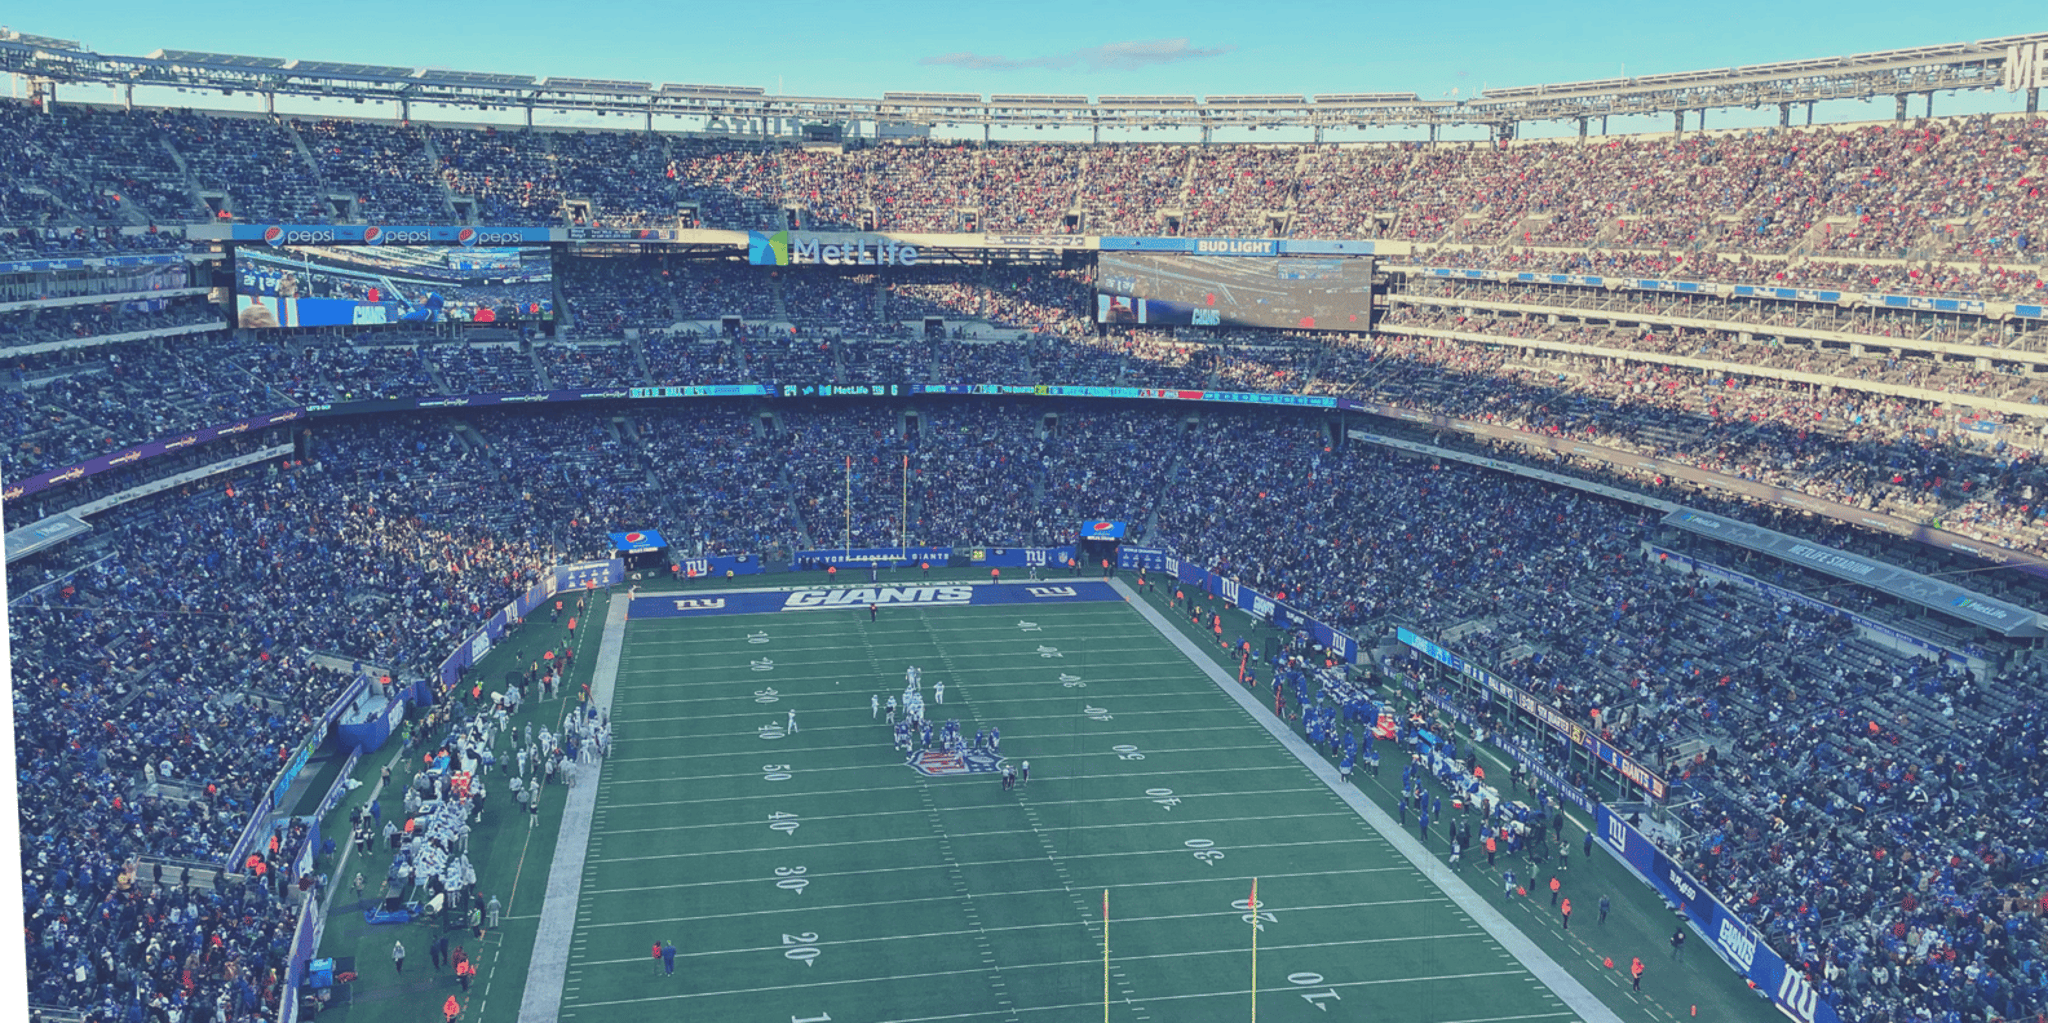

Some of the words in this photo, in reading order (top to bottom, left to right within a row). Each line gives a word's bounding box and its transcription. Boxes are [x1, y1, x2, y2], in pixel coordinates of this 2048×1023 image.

[287, 230, 335, 244] pepsi
[385, 230, 431, 245] pepsi
[478, 230, 523, 245] pepsi
[793, 238, 917, 266] MetLife
[1198, 241, 1228, 253] BUD
[1230, 241, 1272, 253] LIGHT
[784, 385, 797, 396] 24
[833, 386, 869, 395] MetLife
[891, 384, 898, 396] 6
[1025, 550, 1046, 566] ny
[1788, 543, 1833, 563] METLIFE
[785, 586, 973, 606] GIANTS
[1025, 585, 1077, 598] ny
[1221, 577, 1239, 605] ny
[673, 598, 726, 610] ny
[1968, 602, 2008, 619] MetLife
[1332, 632, 1346, 657] ny
[754, 689, 779, 704] 30
[1084, 707, 1113, 722] 40
[758, 724, 785, 739] 40
[1112, 744, 1145, 760] 50
[763, 763, 792, 781] 50
[1622, 757, 1649, 788] GIANTS
[1146, 788, 1182, 807] 40
[768, 811, 800, 831] 40
[1609, 815, 1627, 853] ny
[1184, 838, 1225, 861] 30
[775, 865, 809, 889] 30
[1231, 898, 1278, 925] 20
[782, 932, 820, 960] 20
[1719, 918, 1756, 967] GIANTS
[1287, 971, 1341, 1003] 10
[1776, 964, 1819, 1023] ny
